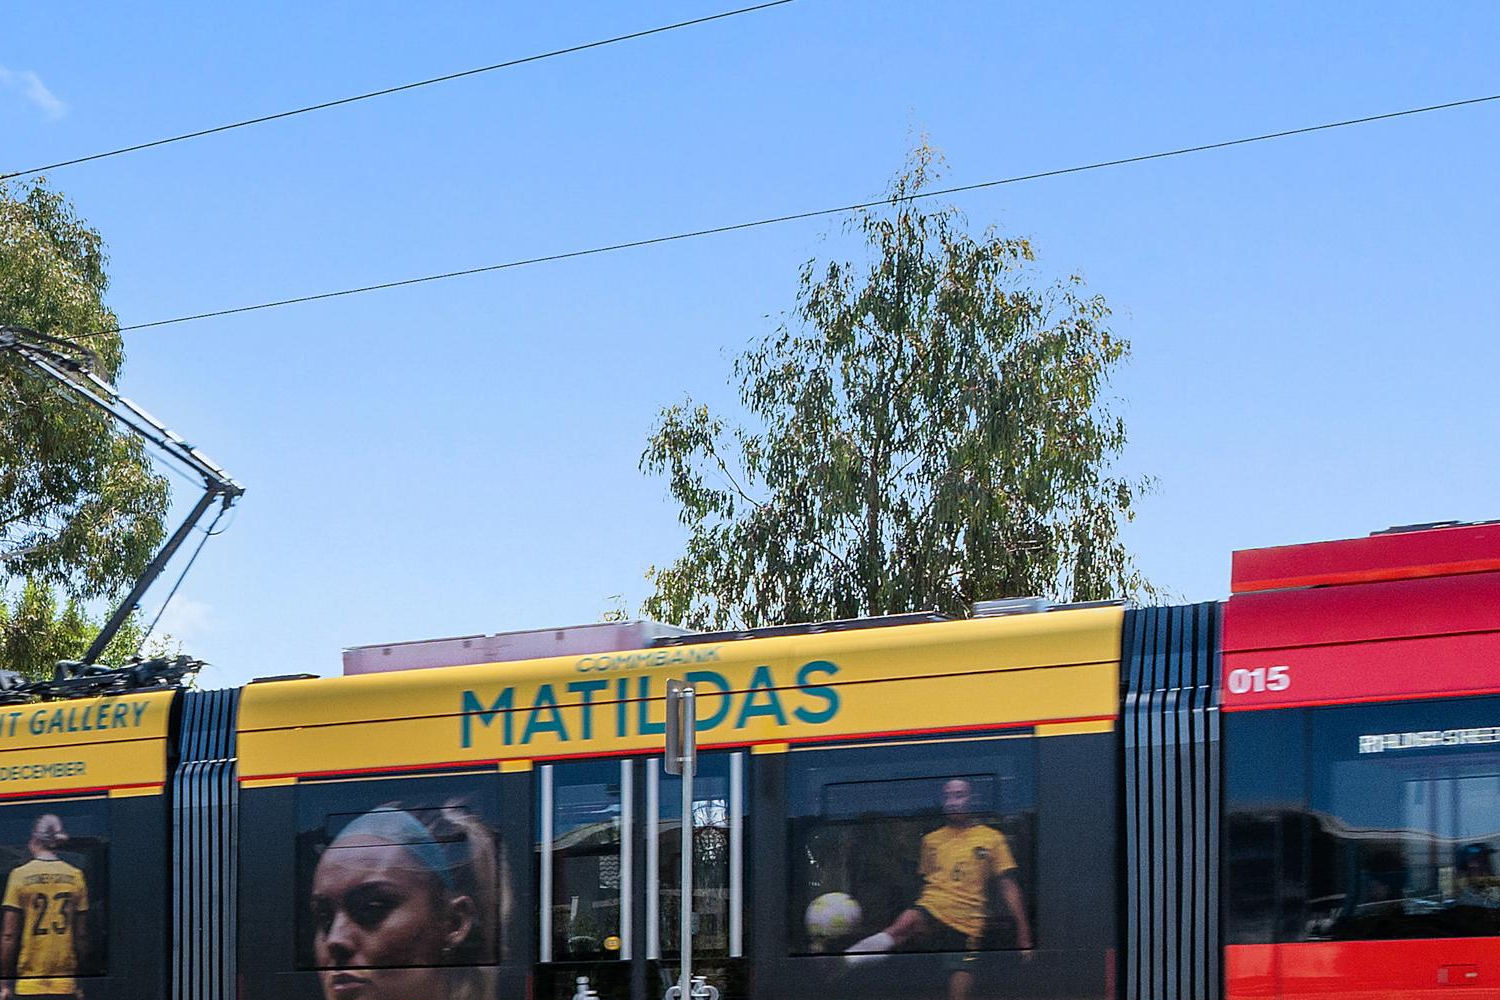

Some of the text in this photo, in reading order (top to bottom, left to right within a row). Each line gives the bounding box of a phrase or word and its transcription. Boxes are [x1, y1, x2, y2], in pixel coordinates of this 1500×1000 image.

[575, 646, 723, 673] COMMBANK
[1228, 665, 1291, 694] 015
[29, 701, 150, 735] GALLERY
[460, 660, 842, 748] MATILDAS
[0, 761, 86, 782] DECEMBER
[32, 892, 71, 935] 23
